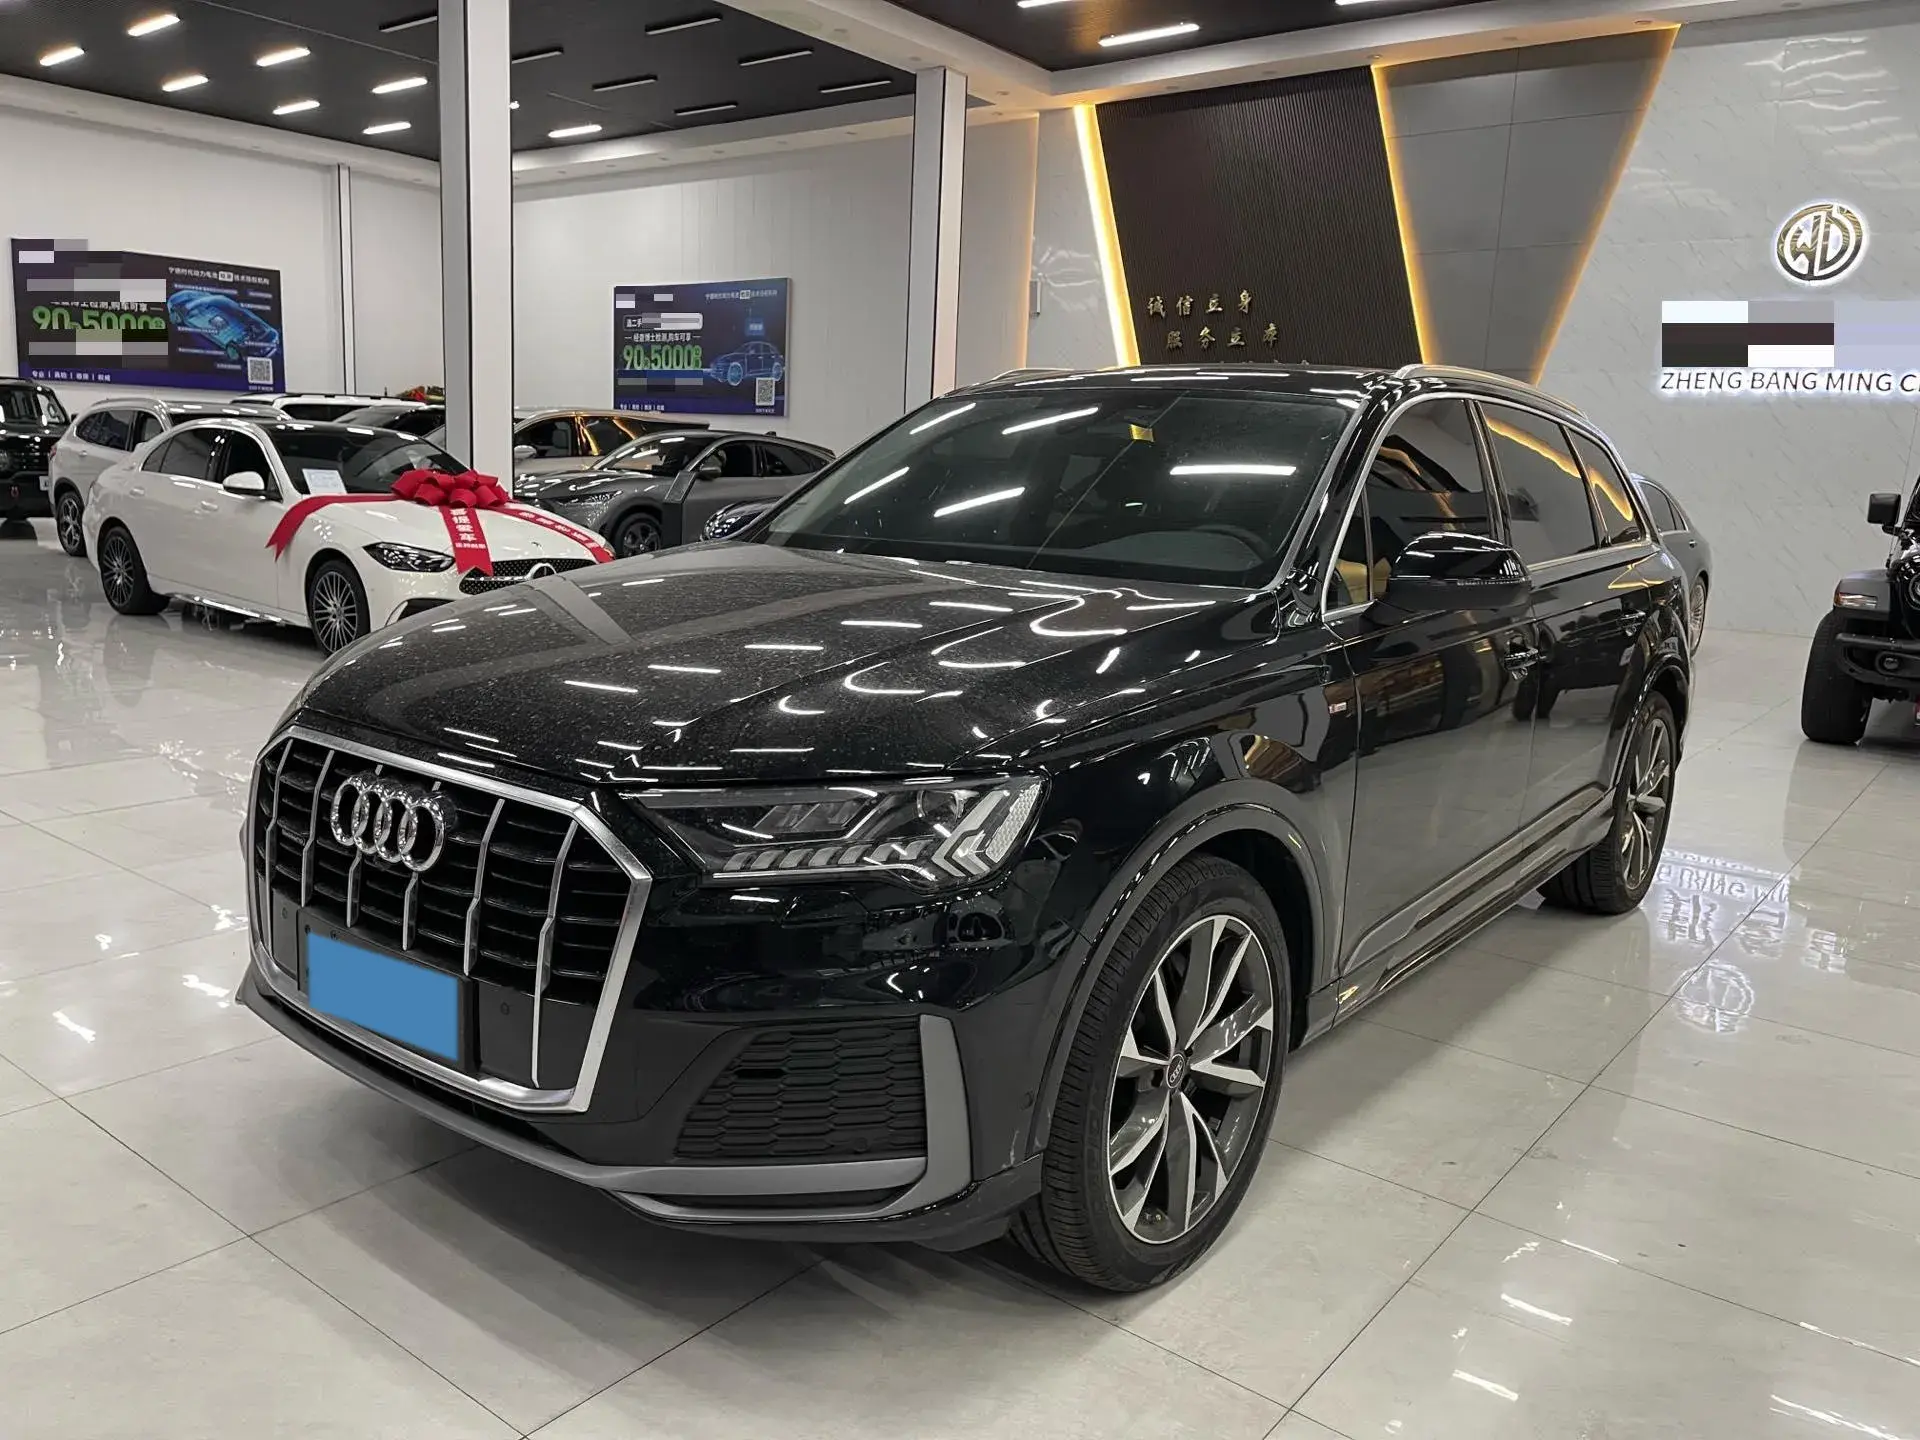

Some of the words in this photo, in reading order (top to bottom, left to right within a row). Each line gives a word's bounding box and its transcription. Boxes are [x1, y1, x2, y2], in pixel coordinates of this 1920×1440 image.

[1661, 371, 1743, 391] ZHENG
[1749, 371, 1818, 391] BANG
[1825, 373, 1892, 393] MING
[1899, 374, 1920, 393] C
